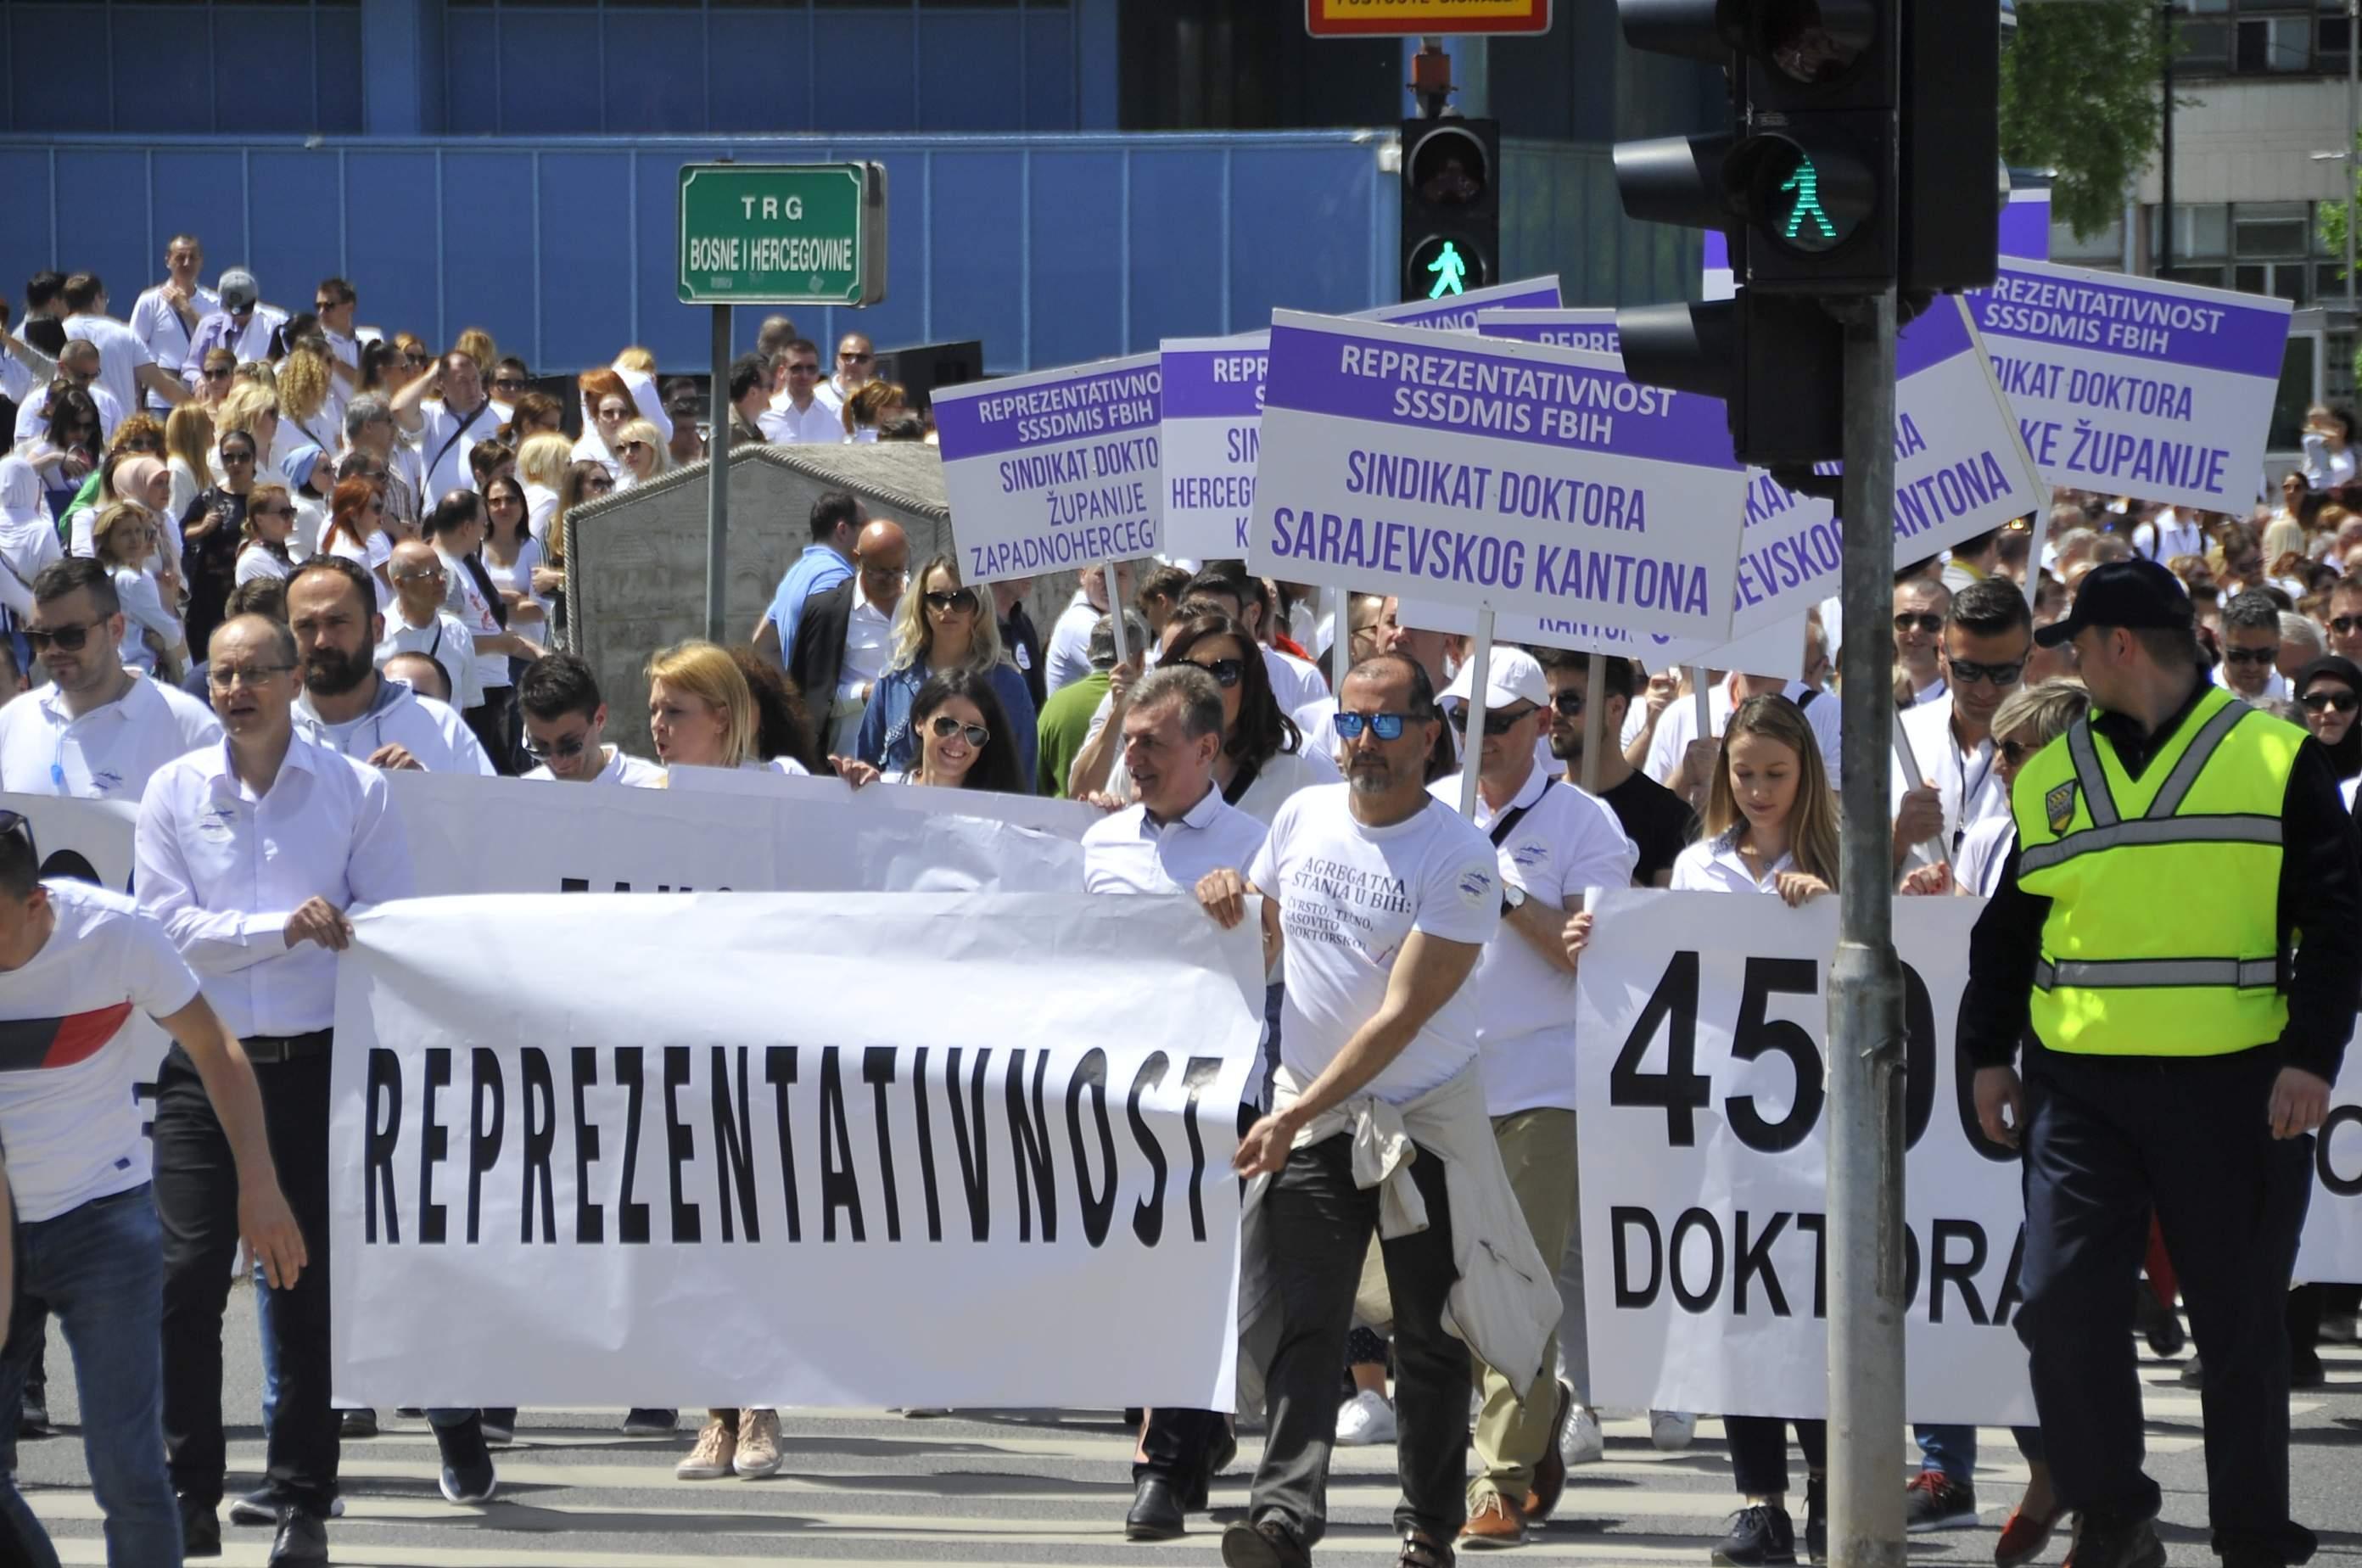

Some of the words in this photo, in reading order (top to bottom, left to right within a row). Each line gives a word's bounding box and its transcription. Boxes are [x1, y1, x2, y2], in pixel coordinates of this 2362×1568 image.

[742, 196, 803, 220] TRG
[691, 238, 739, 272] BOSNE
[742, 238, 747, 272] I
[751, 238, 853, 272] HERCEGOVINE
[1963, 275, 2225, 335] REZENTATIVNOST
[1984, 303, 2101, 344] SSSDMIS
[2107, 322, 2170, 356] FBIH
[978, 371, 1161, 423] REPREZENTATIVNO
[1341, 344, 1677, 417] REPREZENTATIVNOST
[2068, 371, 2192, 423] DOKTORA
[1017, 406, 1104, 444] SSSDMIS
[1109, 399, 1153, 432] FBIH
[1392, 387, 1532, 434] SSSDMIS
[1541, 407, 1614, 445] FBIH
[999, 448, 1088, 493] SINDIKAT
[2066, 417, 2230, 495] ŽUPANIJE
[1046, 482, 1147, 527] ŽUPANIJE
[1173, 477, 1257, 509] HERCEG
[1346, 450, 1492, 509] SINDIKAT
[1498, 470, 1647, 534] DOKTORA
[971, 518, 1156, 578] ZAPADNOHERCEG
[1272, 507, 1525, 590] SARAJEVSKOG
[1534, 544, 1709, 618] KANTONA
[1733, 516, 1843, 613] EVSKO
[1291, 871, 1351, 900] STANJA
[1354, 886, 1366, 905] U
[1369, 891, 1412, 915] BIH:
[1302, 856, 1406, 897] AGREGATNA
[363, 1045, 1227, 1248] REPREZENTATIVNOST
[1611, 1206, 2024, 1327] DOKTR
